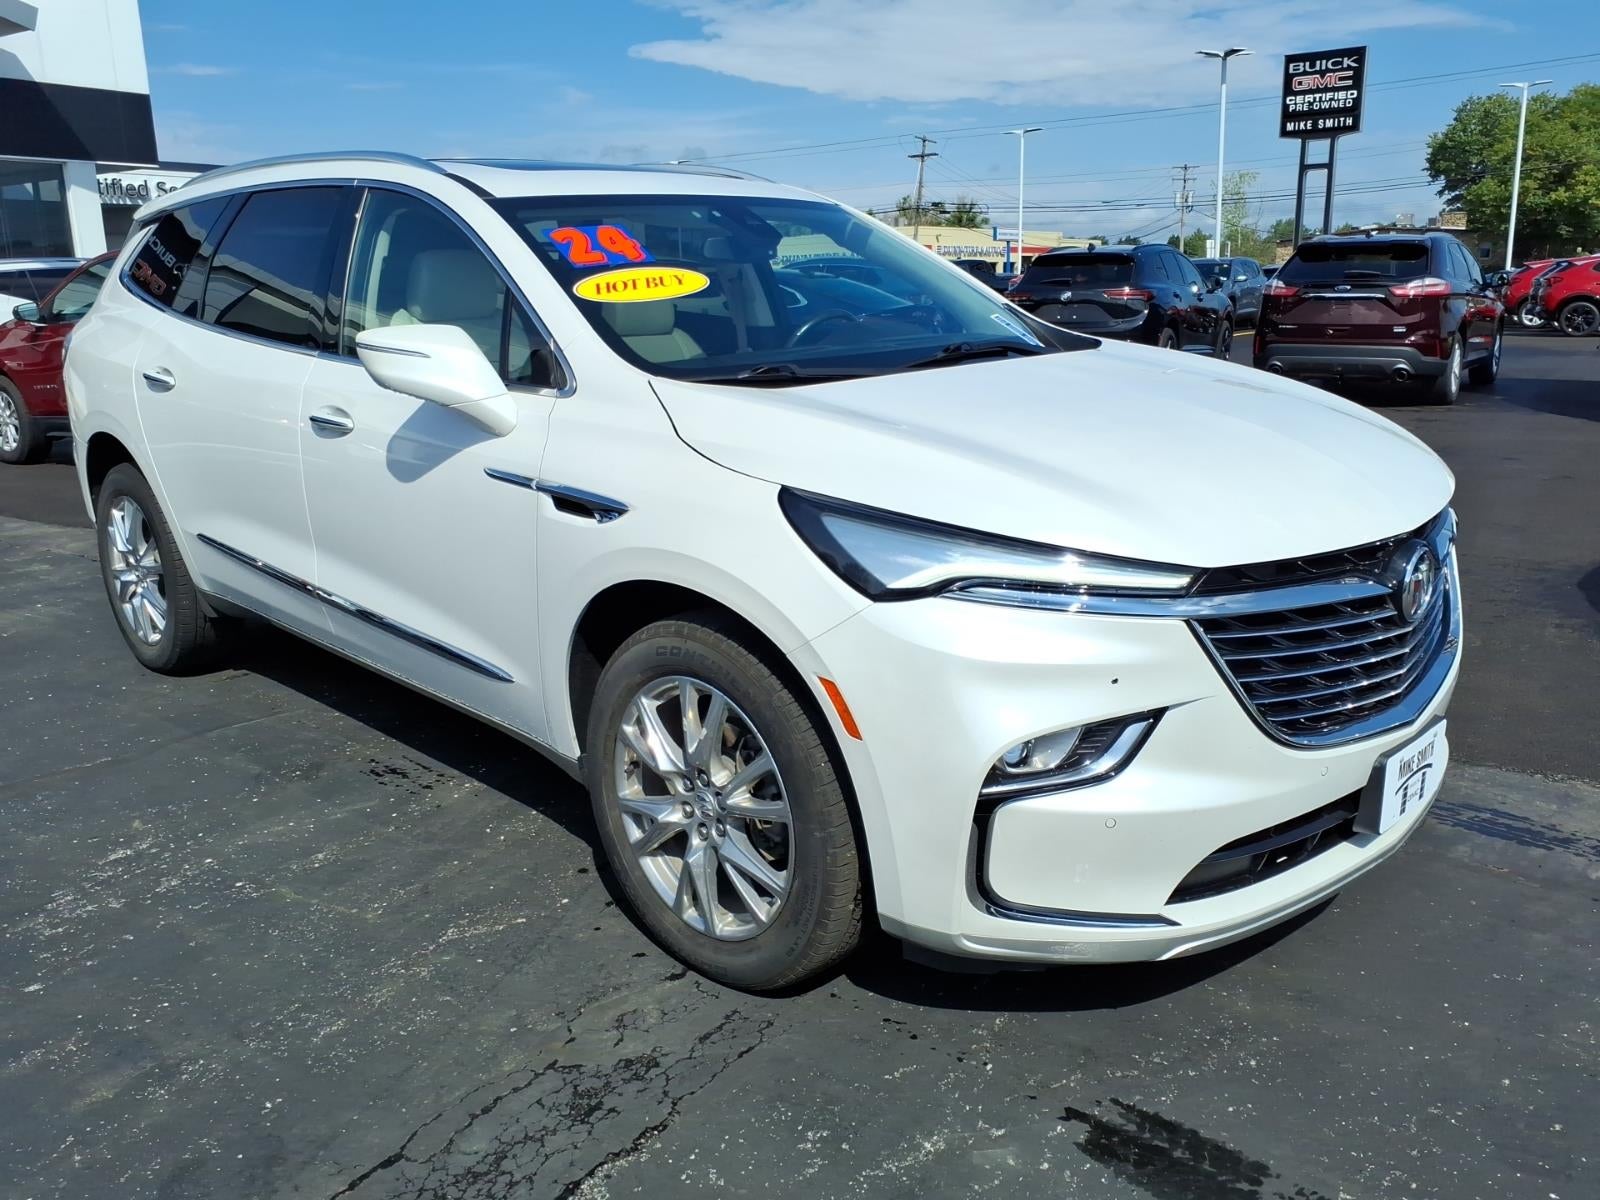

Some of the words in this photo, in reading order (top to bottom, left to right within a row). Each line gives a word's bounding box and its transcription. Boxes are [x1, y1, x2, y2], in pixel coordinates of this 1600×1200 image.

[1289, 56, 1359, 73] BUICK
[1292, 71, 1353, 91] GMC
[1286, 90, 1357, 104] CERTIFIED
[1289, 99, 1353, 112] PRE-OWNED
[1286, 120, 1313, 131] MIKE
[1318, 117, 1353, 129] SMITH
[550, 225, 646, 264] 24
[595, 279, 640, 296] HOT
[645, 274, 686, 289] BUY
[1398, 754, 1416, 781] MIKE
[1416, 740, 1435, 768] SMITH
